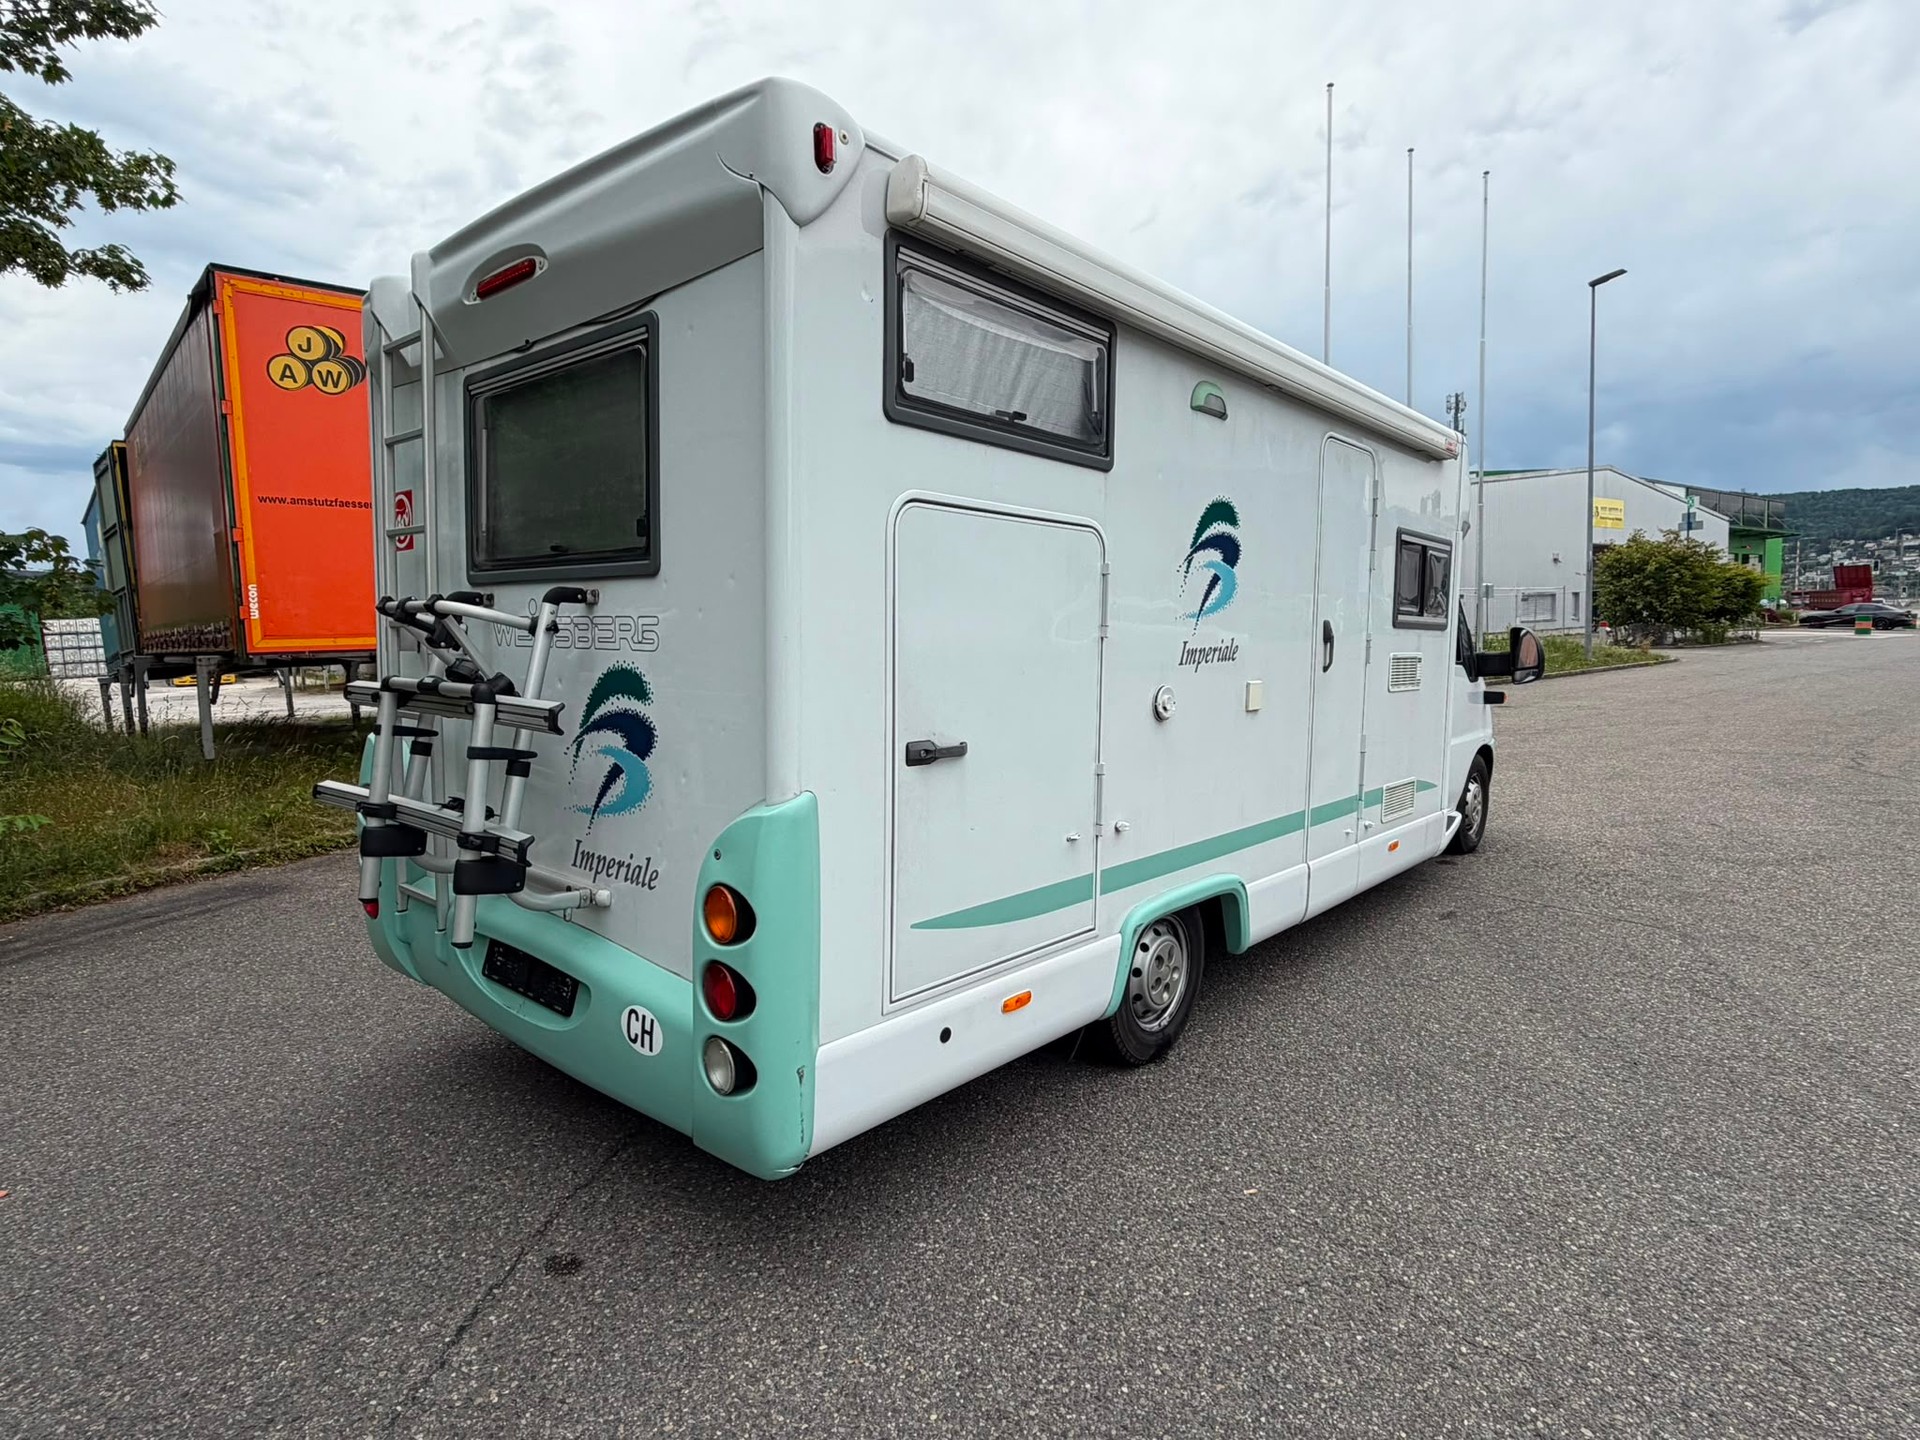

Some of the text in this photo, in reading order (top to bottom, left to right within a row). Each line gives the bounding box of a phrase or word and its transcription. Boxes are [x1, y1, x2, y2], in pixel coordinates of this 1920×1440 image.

[297, 336, 312, 353] J
[278, 363, 343, 389] A W
[247, 584, 260, 619] wecon
[493, 598, 660, 652] WESBERG
[1178, 637, 1239, 673] Imperiale
[571, 839, 660, 891] Imperiale
[626, 1008, 655, 1053] CH
